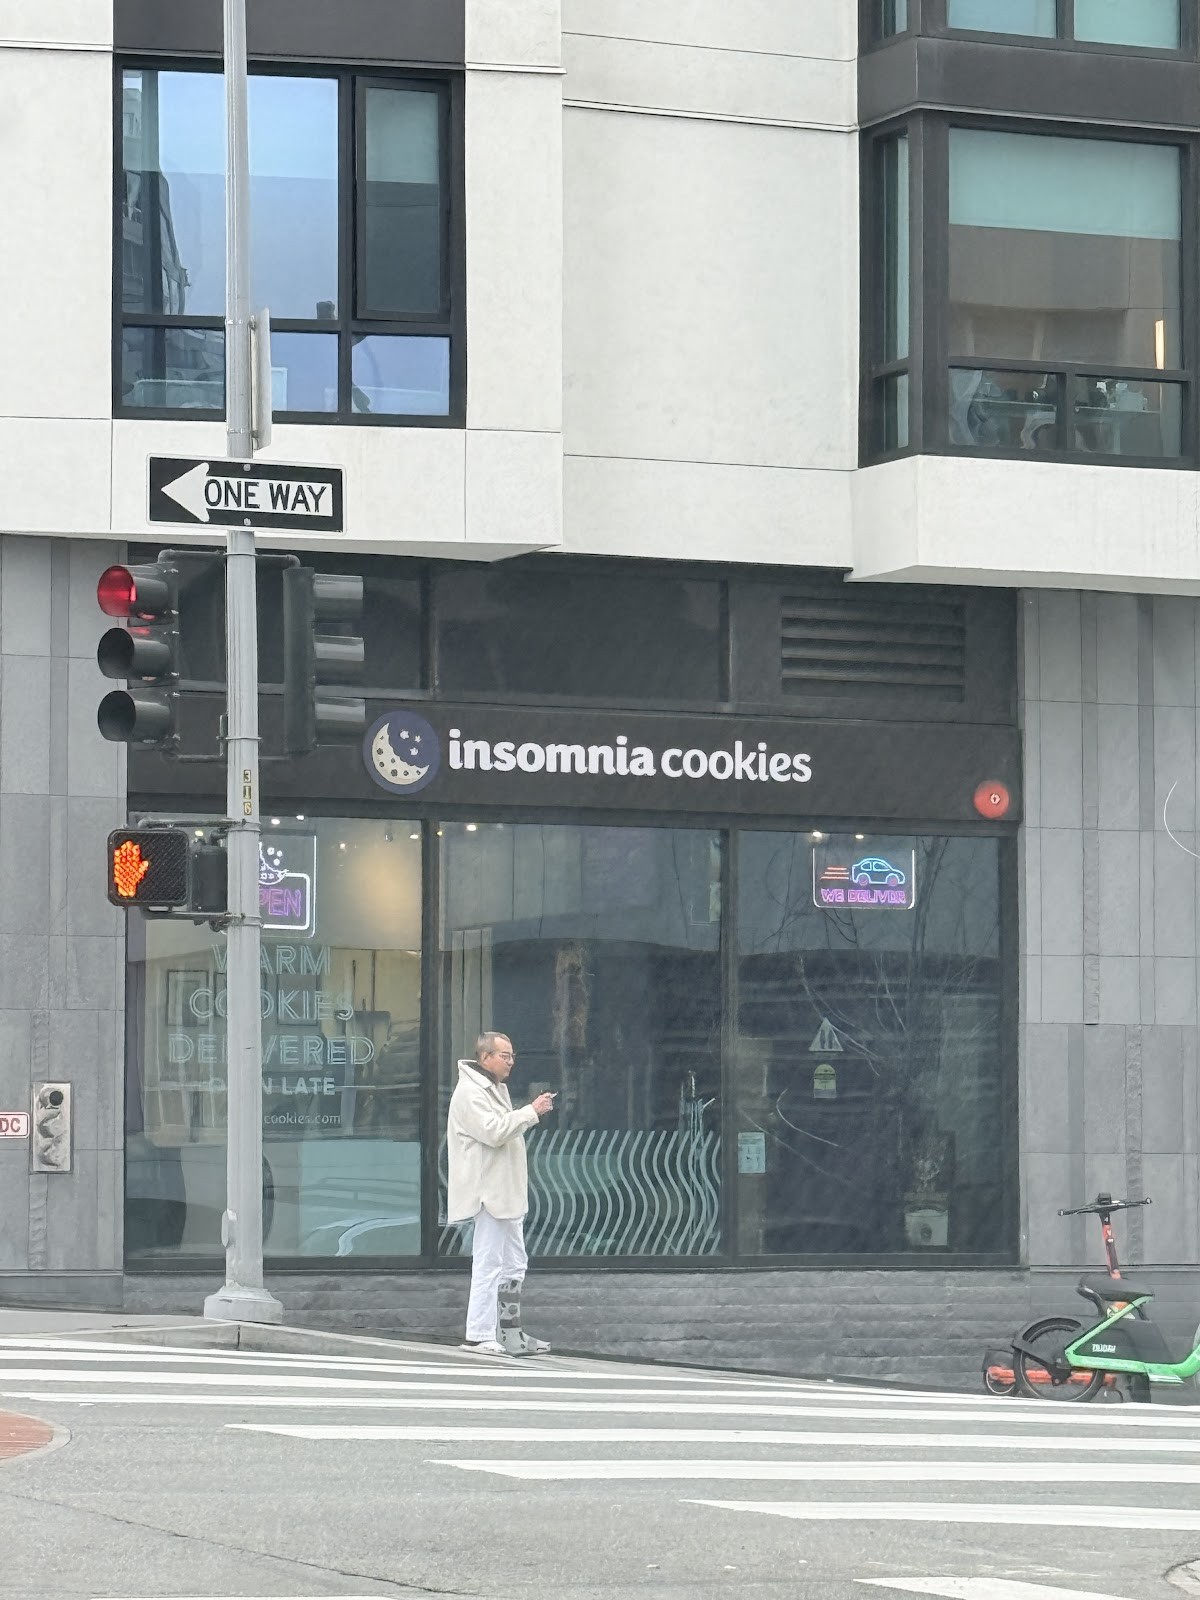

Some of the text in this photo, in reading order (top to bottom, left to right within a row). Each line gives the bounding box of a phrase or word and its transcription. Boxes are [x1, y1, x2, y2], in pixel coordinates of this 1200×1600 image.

[204, 478, 327, 513] ONE WAY
[449, 728, 813, 783] insomnia cookies
[820, 887, 844, 903] WE
[281, 1076, 336, 1096] LATE
